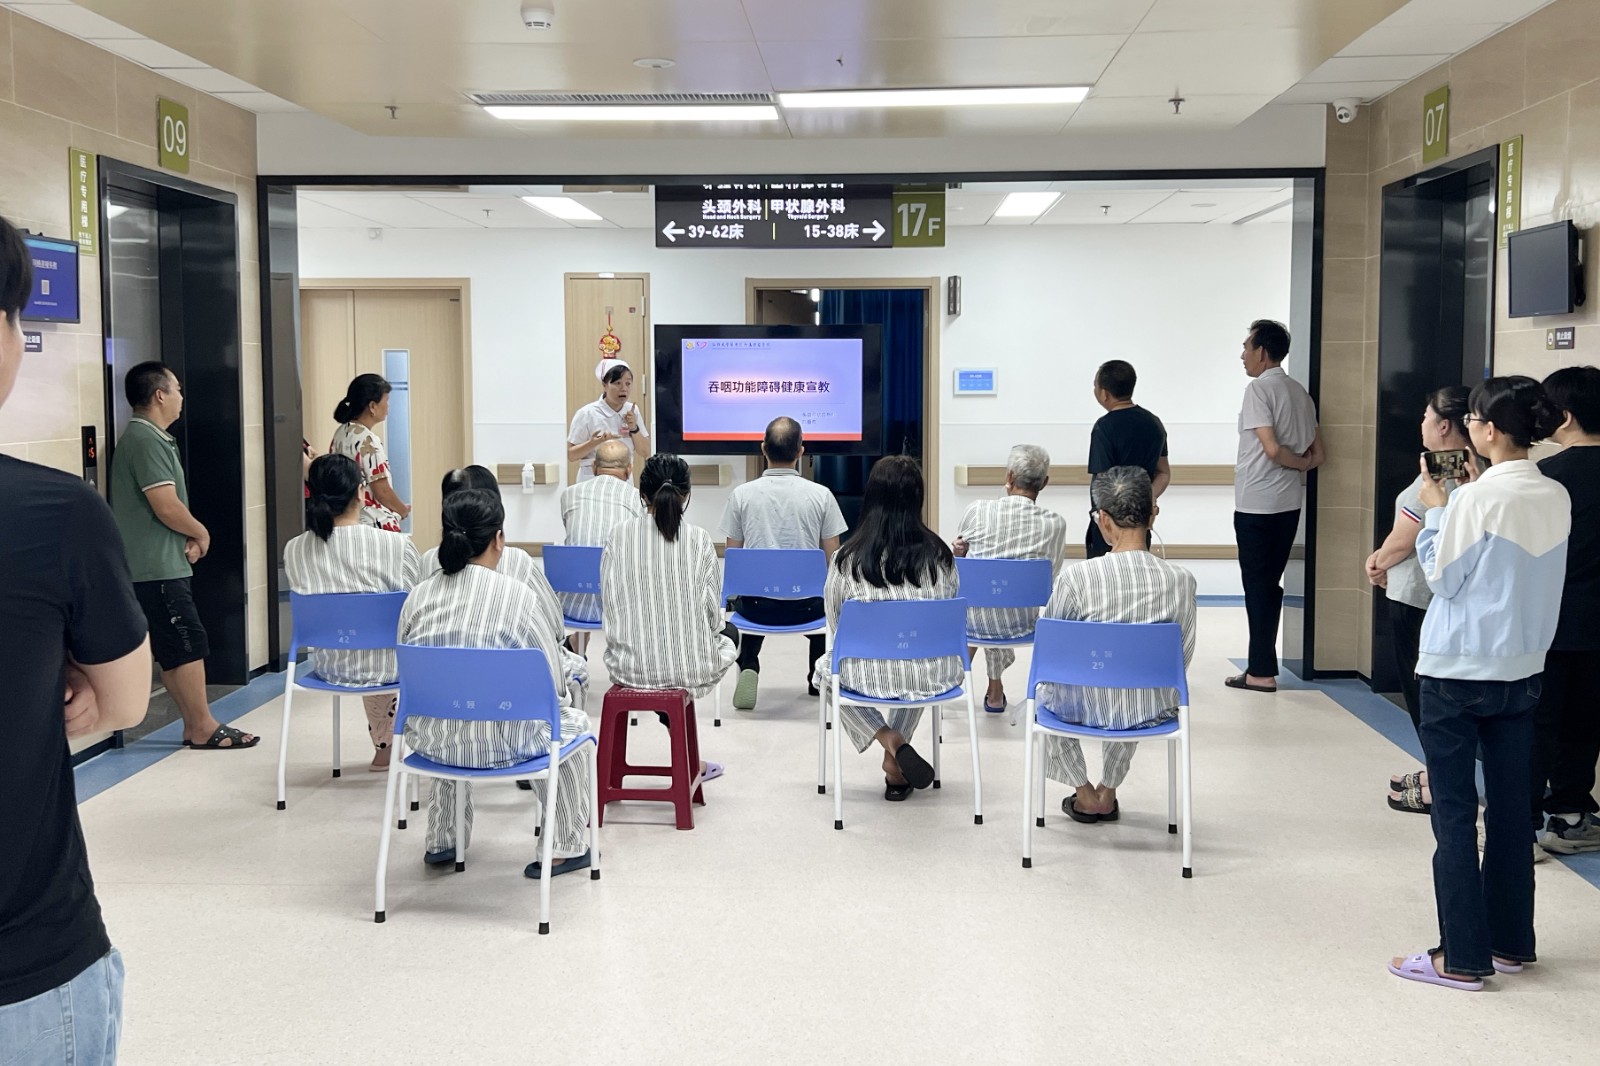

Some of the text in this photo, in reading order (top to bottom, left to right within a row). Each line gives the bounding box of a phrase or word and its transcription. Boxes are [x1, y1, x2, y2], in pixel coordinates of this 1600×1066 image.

[1426, 103, 1444, 146] 07
[164, 116, 186, 156] 09
[702, 199, 761, 214] 头颈外科
[771, 199, 845, 214] 甲状腺外科
[688, 224, 744, 239] 39-62床
[803, 223, 860, 239] 15-38床
[708, 380, 830, 394] 吞咽功能障碍健康宣教
[1091, 661, 1105, 670] 29
[499, 700, 513, 711] 49
